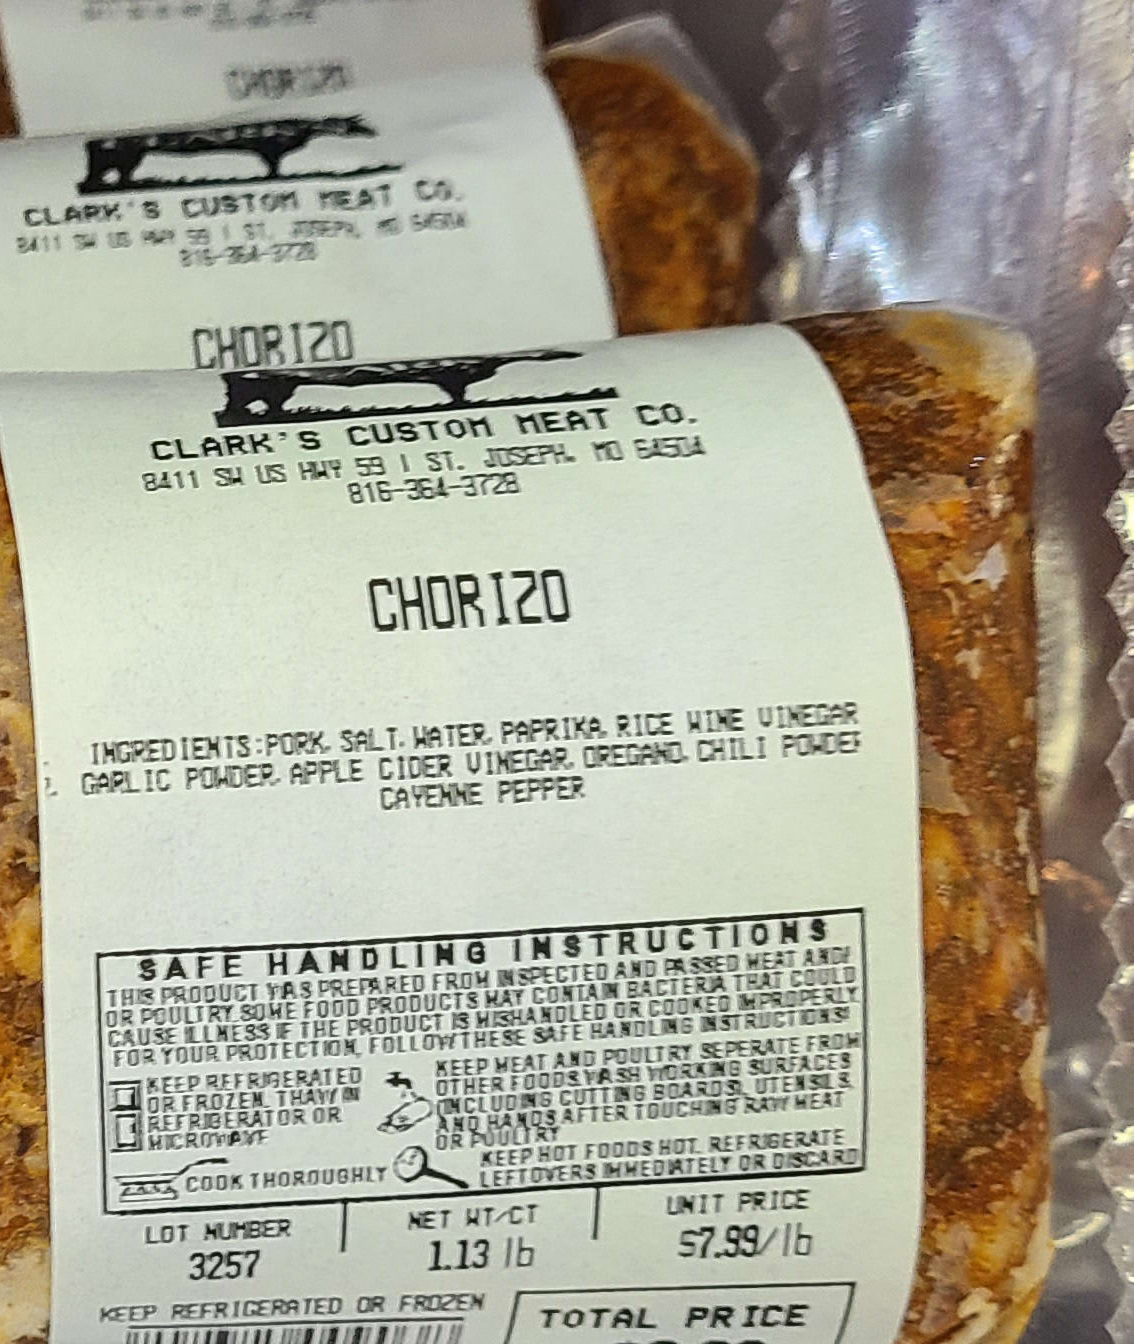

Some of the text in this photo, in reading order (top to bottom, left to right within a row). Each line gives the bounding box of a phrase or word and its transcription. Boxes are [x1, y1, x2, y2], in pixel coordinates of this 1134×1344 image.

[23, 200, 163, 227] CLARK'S
[181, 191, 299, 218] CUSTOM
[317, 184, 392, 211] MEAT
[191, 320, 355, 370] CHORIZO
[150, 403, 698, 461] CLARK'S CUSTOM MEAT CO.
[142, 468, 200, 492] 8411
[214, 466, 244, 488] SW
[258, 463, 287, 485] US
[300, 459, 342, 482] HWY
[356, 455, 386, 478] 59
[426, 450, 465, 473] ST.
[592, 439, 623, 464] MO
[636, 435, 707, 461] 64504
[348, 472, 522, 505] 816-364-3728
[367, 569, 571, 634] CHORIZO
[616, 712, 675, 739] RICE
[688, 708, 746, 734] WINE
[82, 768, 172, 797] GARLIC
[289, 758, 364, 786] APPLE
[379, 753, 454, 782] CIDER
[696, 736, 767, 763] CHILI
[380, 775, 586, 811] CAYENNE PEPPER
[138, 917, 828, 983] SAFE HANDLING INSTRUCTIONS
[106, 988, 155, 1009] THIS
[161, 981, 260, 1006] PRODUCT
[318, 972, 425, 998] PREPARED
[432, 968, 490, 993] FROM
[497, 962, 608, 990] INSPECTED
[614, 957, 657, 981] AND
[665, 953, 739, 977] PASSED
[747, 949, 796, 972] MEAT
[106, 1008, 134, 1029] OR
[240, 1000, 297, 1022] SOME
[303, 996, 361, 1019] FOOD
[367, 991, 479, 1016] PRODUCTS
[485, 988, 524, 1009] MAY
[531, 981, 619, 1006] CONTAIN
[626, 975, 728, 1000] BACTERIA
[733, 970, 783, 993] THAT
[789, 966, 857, 989] COULD
[106, 1025, 178, 1048] CAUSE
[184, 1022, 269, 1045] ILLNESS
[274, 1021, 293, 1040] IF
[299, 1018, 341, 1040] THE
[346, 1013, 443, 1037] PRODUCT
[450, 1010, 471, 1031] IS
[476, 1002, 607, 1028] MISHANDLED
[613, 999, 641, 1020] OR
[647, 994, 731, 1018] COOKED
[113, 1046, 156, 1069] FOR
[161, 1044, 221, 1067] YOUR
[368, 1031, 454, 1057] FOLLOW
[457, 1027, 528, 1053] THESE
[533, 1023, 584, 1046] SAFE
[590, 1016, 694, 1042] HANDLING
[435, 1031, 862, 1078] KEEP MEAT AND POULTRY SEPERATE FROM
[146, 1066, 363, 1095] KEEP REFRIGERATED
[435, 1074, 506, 1097] OTHER
[584, 1066, 642, 1087] WASH
[647, 1059, 742, 1083] WORKING
[748, 1052, 853, 1077] SURFACES
[147, 1095, 177, 1114] OR
[277, 1087, 339, 1108] THAW
[435, 1090, 844, 1134] AND HANDS AFTER TOUCHING RAW MEAT
[559, 1084, 646, 1107] CUTTING
[147, 1106, 343, 1132] REFRIGERATOR OR
[147, 1130, 270, 1151] MICROWAVE
[435, 1125, 561, 1151] OR POULTRY
[481, 1148, 533, 1168] KEEP
[540, 1143, 580, 1164] HOT
[585, 1138, 655, 1159] FOODS
[709, 1128, 846, 1154] REFRIGERATE
[185, 1166, 388, 1194] COOK THOROUGHLY
[480, 1148, 859, 1189] LEFTOVERS IMMEDIATELY OR DISCARD
[408, 1204, 540, 1232] NET WT/CT
[667, 1188, 811, 1216] UNIT PRICE
[144, 1218, 293, 1246] LOT NUMBER
[188, 1250, 261, 1282] 3257
[427, 1237, 535, 1273] 1.13 lb
[100, 1291, 487, 1324] KEEP REFRIGERATED OR FROZEN
[540, 1303, 811, 1330] TOTAL PRICE
